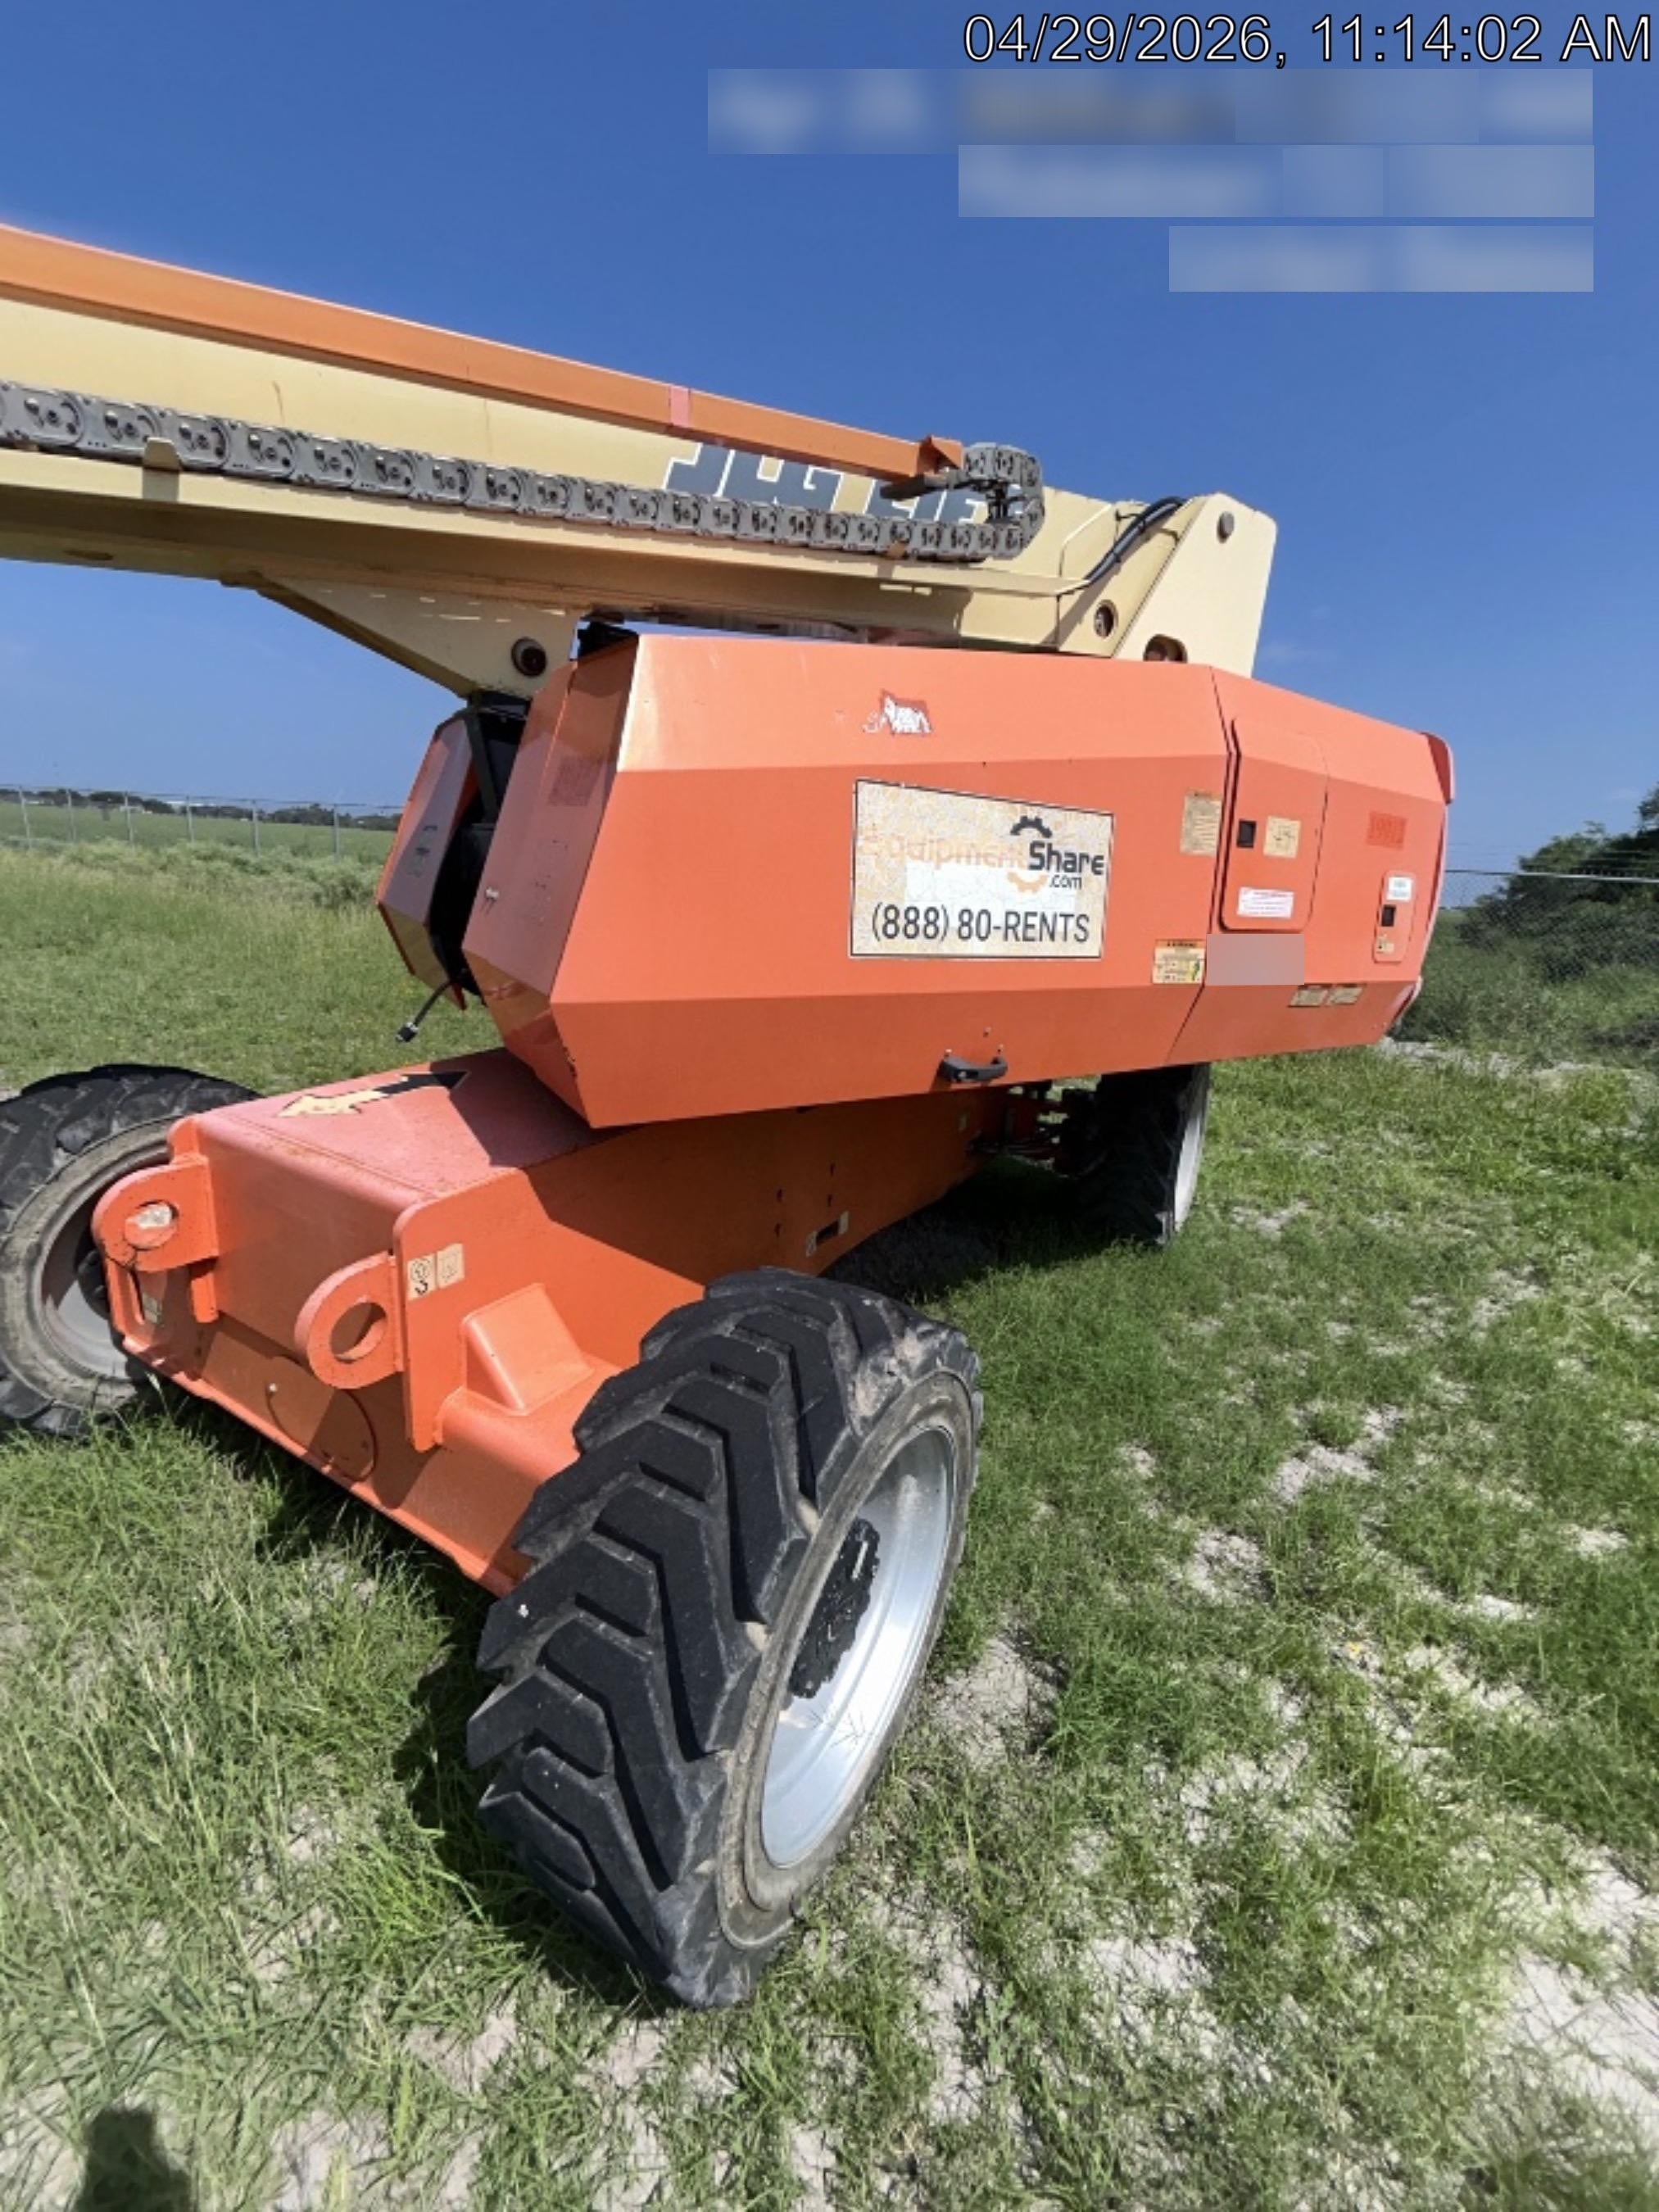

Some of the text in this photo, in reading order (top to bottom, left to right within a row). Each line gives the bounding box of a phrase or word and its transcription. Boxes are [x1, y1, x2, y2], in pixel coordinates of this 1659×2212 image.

[1049, 874, 1083, 890] .com
[872, 901, 1090, 943] (888) 80-RENTS
